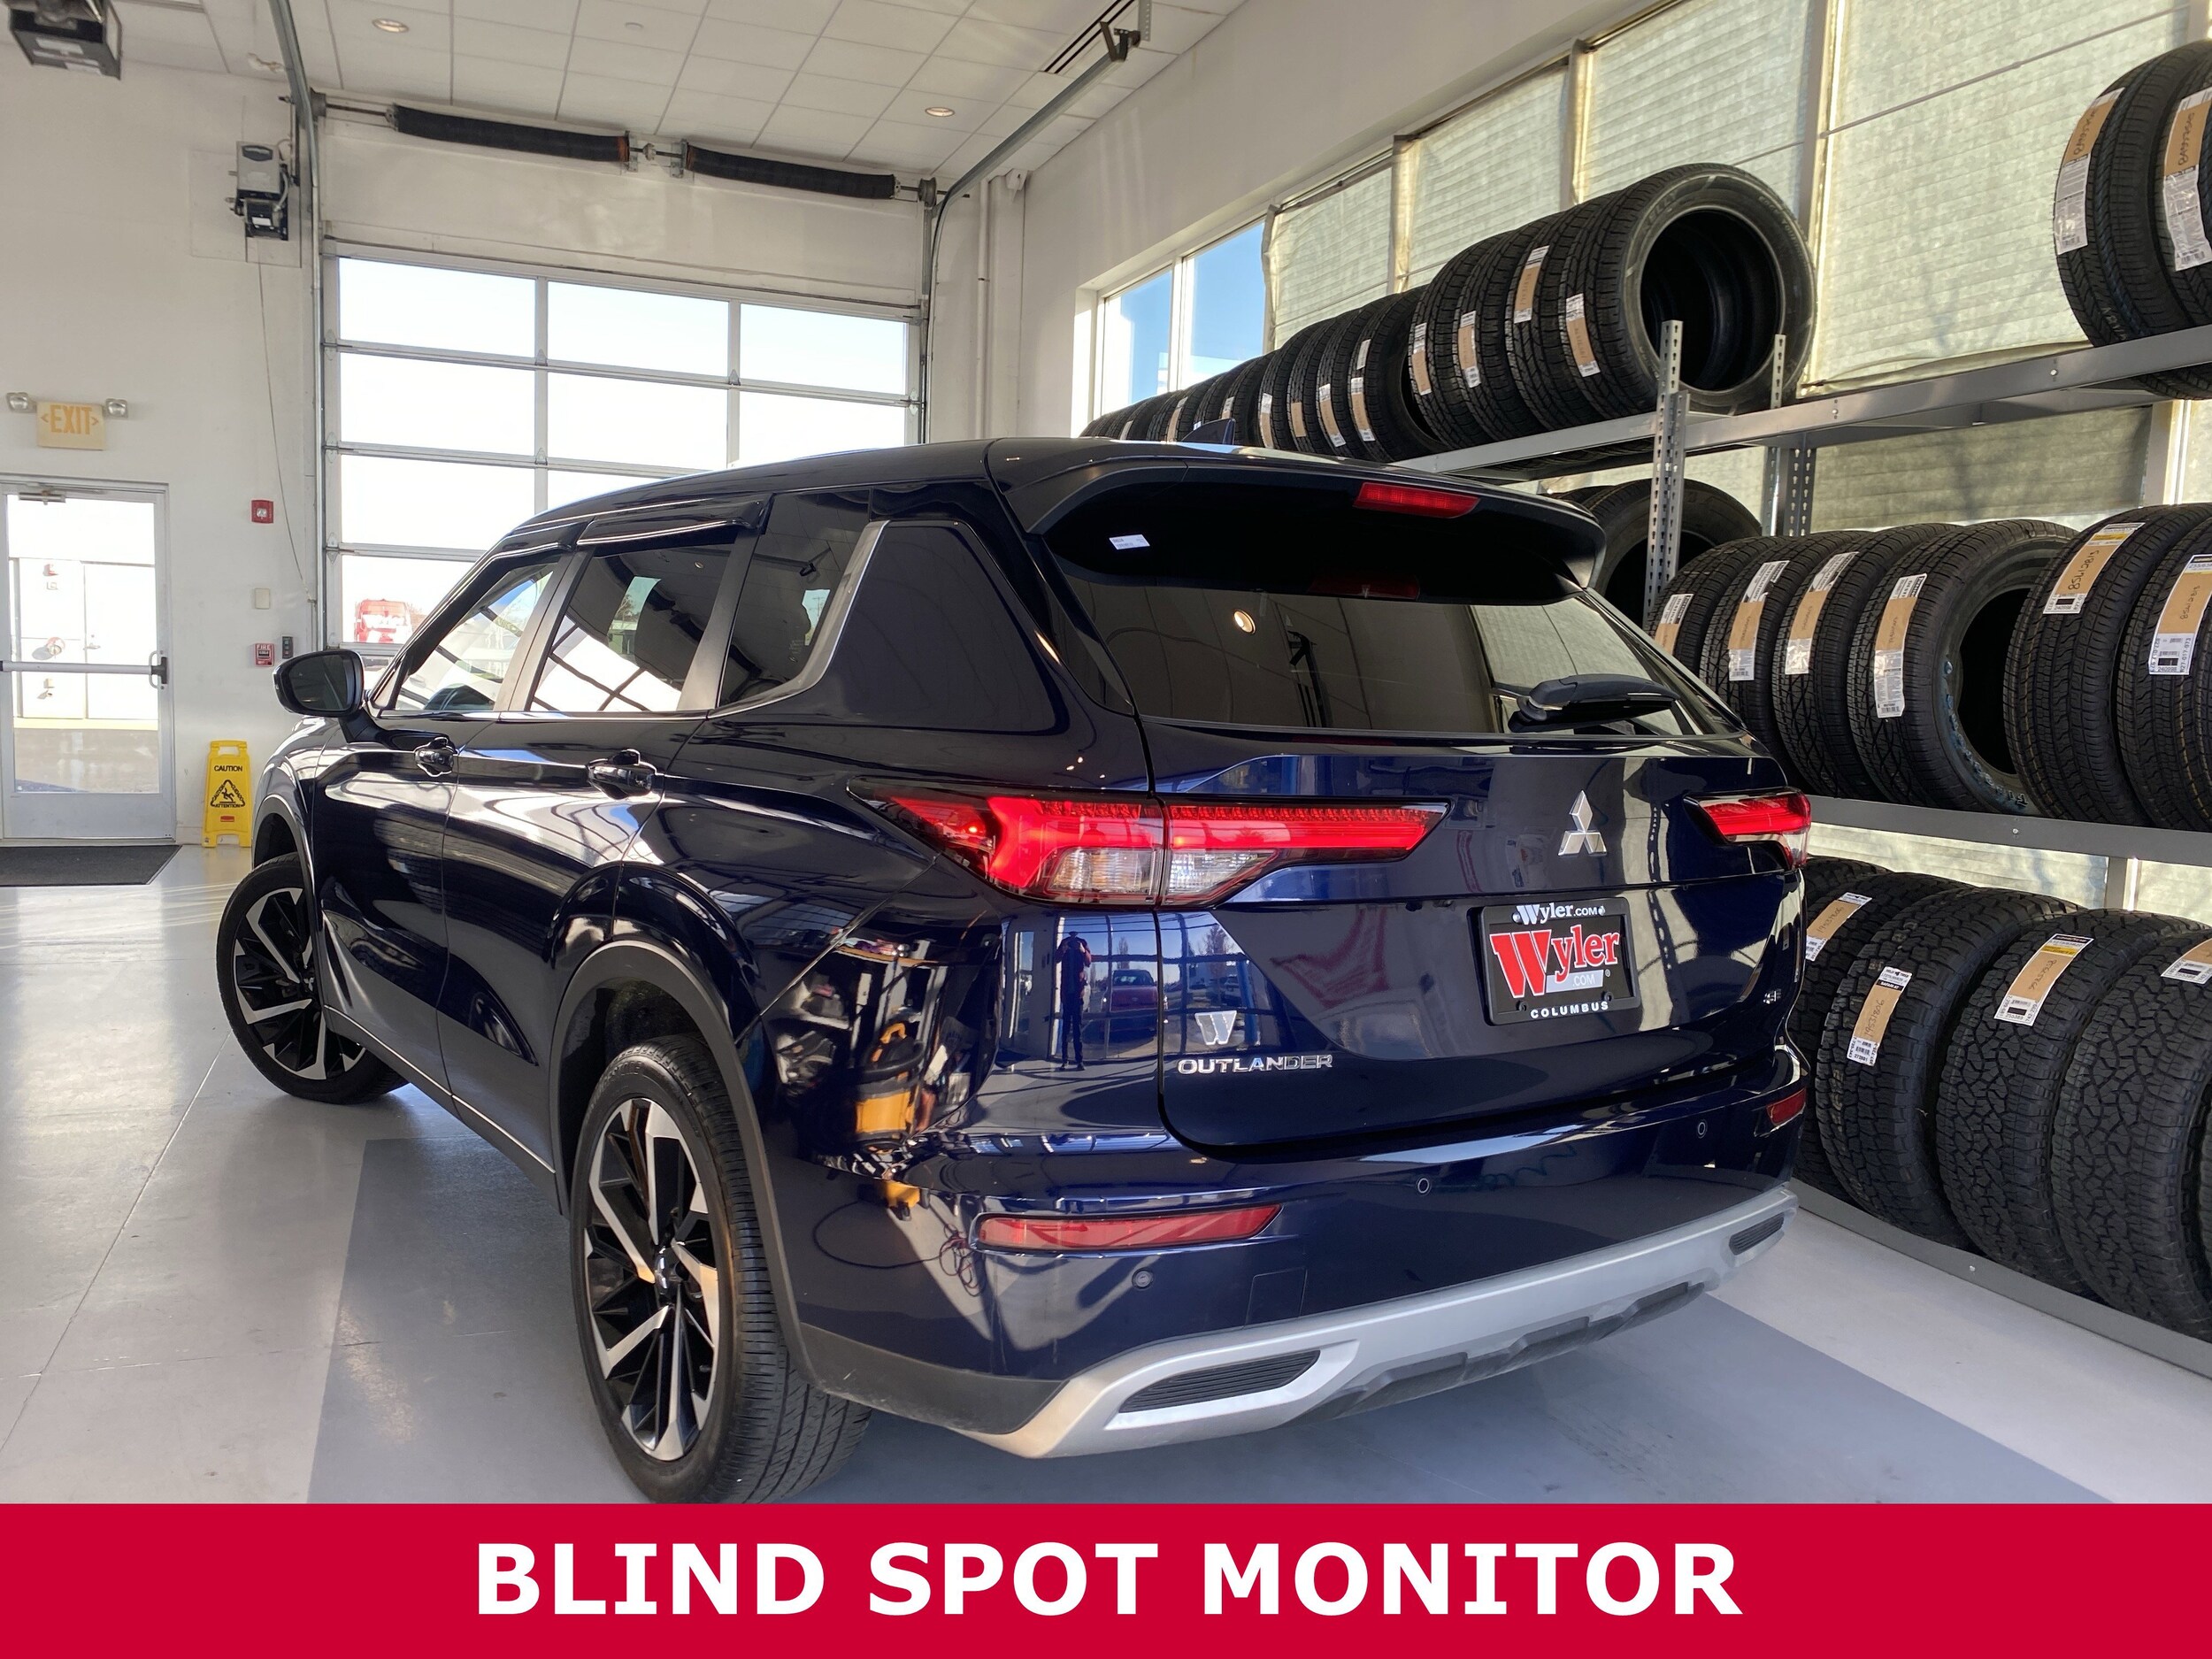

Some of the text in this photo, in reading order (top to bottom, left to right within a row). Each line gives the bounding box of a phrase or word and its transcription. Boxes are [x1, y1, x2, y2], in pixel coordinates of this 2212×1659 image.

[50, 404, 93, 434] EXIT
[1489, 924, 1620, 999] Wyler
[1530, 1001, 1609, 1018] COLUMBUS
[1178, 1054, 1333, 1074] OUTLANDER
